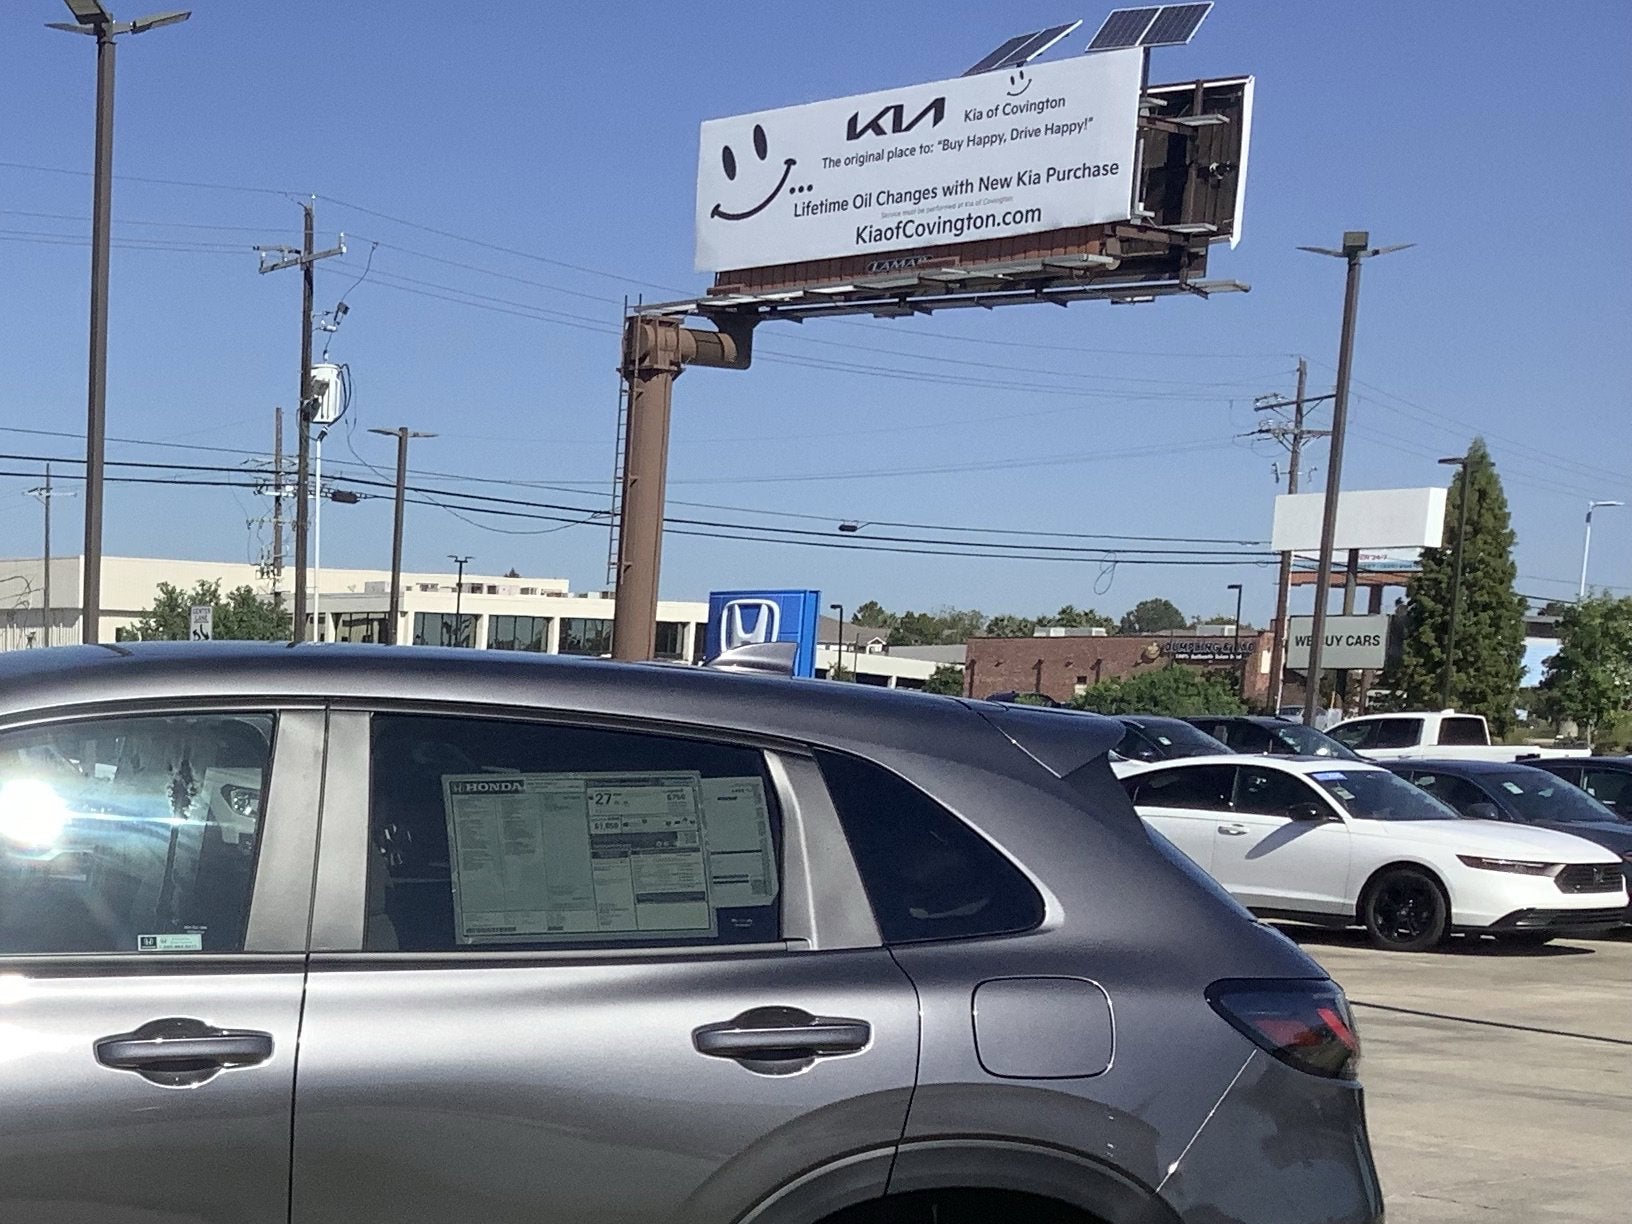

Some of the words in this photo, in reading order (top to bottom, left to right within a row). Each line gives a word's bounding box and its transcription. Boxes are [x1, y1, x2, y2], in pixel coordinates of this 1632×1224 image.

[964, 108, 983, 123] Kia
[986, 103, 1000, 119] of
[1003, 97, 1066, 118] Covington
[822, 156, 841, 169] The
[844, 148, 884, 168] original
[887, 144, 916, 162] place
[919, 142, 934, 155] to:
[967, 131, 1007, 149] Happy,
[1010, 124, 1042, 141] Drive
[794, 193, 849, 218] Lifetime
[852, 191, 872, 209] Oil
[876, 183, 938, 208] Changes
[942, 177, 974, 196] with
[978, 172, 1013, 193] New
[1016, 169, 1042, 188] Kia
[1046, 160, 1120, 184] Purchase
[856, 206, 1042, 245] KiaofCovington.com
[1325, 635, 1343, 646] UY
[1345, 635, 1381, 646] CARS
[466, 782, 522, 793] HONDA
[595, 792, 612, 806] 27
